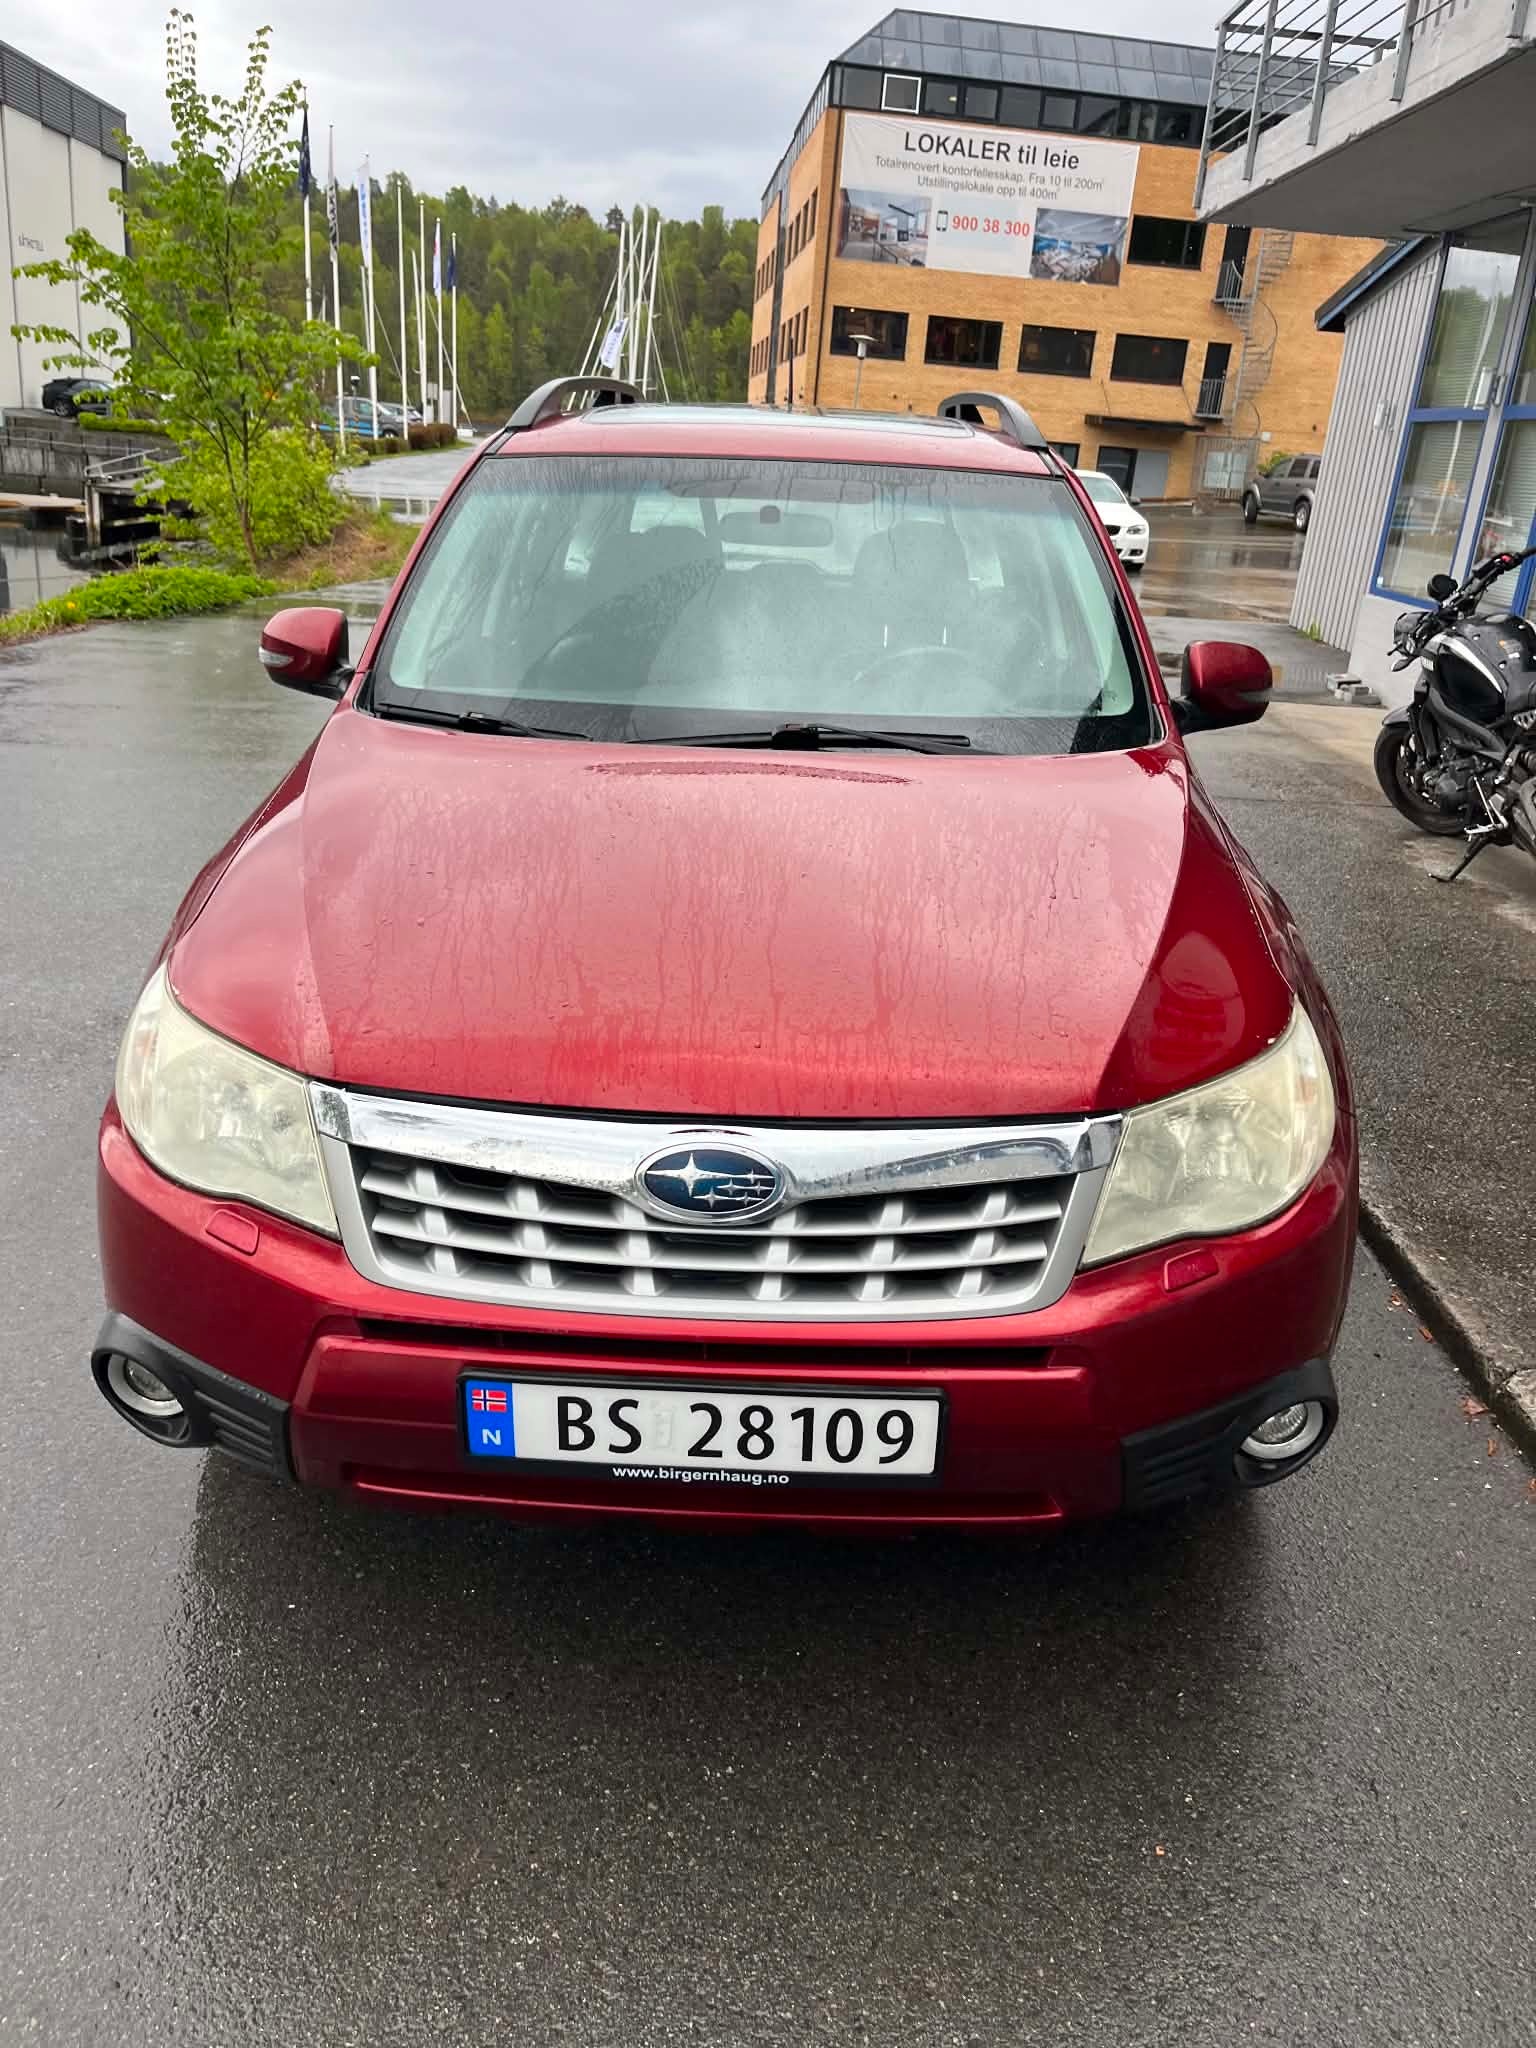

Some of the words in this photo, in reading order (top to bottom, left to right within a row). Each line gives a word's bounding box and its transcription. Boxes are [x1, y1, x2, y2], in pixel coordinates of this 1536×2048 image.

[904, 131, 1011, 162] LOKALER
[1018, 145, 1037, 165] til
[1043, 147, 1080, 170] leie
[876, 155, 940, 173] Totalrenovert
[1028, 172, 1046, 185] Fra
[1050, 175, 1061, 186] 10
[1063, 178, 1072, 188] til
[917, 176, 994, 193] Utstillingslokale
[996, 186, 1016, 198] opp
[1018, 187, 1028, 197] til
[952, 215, 979, 231] 900
[982, 218, 1001, 233] 38
[1004, 221, 1031, 237] 300
[482, 1428, 502, 1446] N
[557, 1396, 642, 1454] BS
[687, 1402, 915, 1464] 28109
[613, 1465, 790, 1486] www.birgernhaug.no
